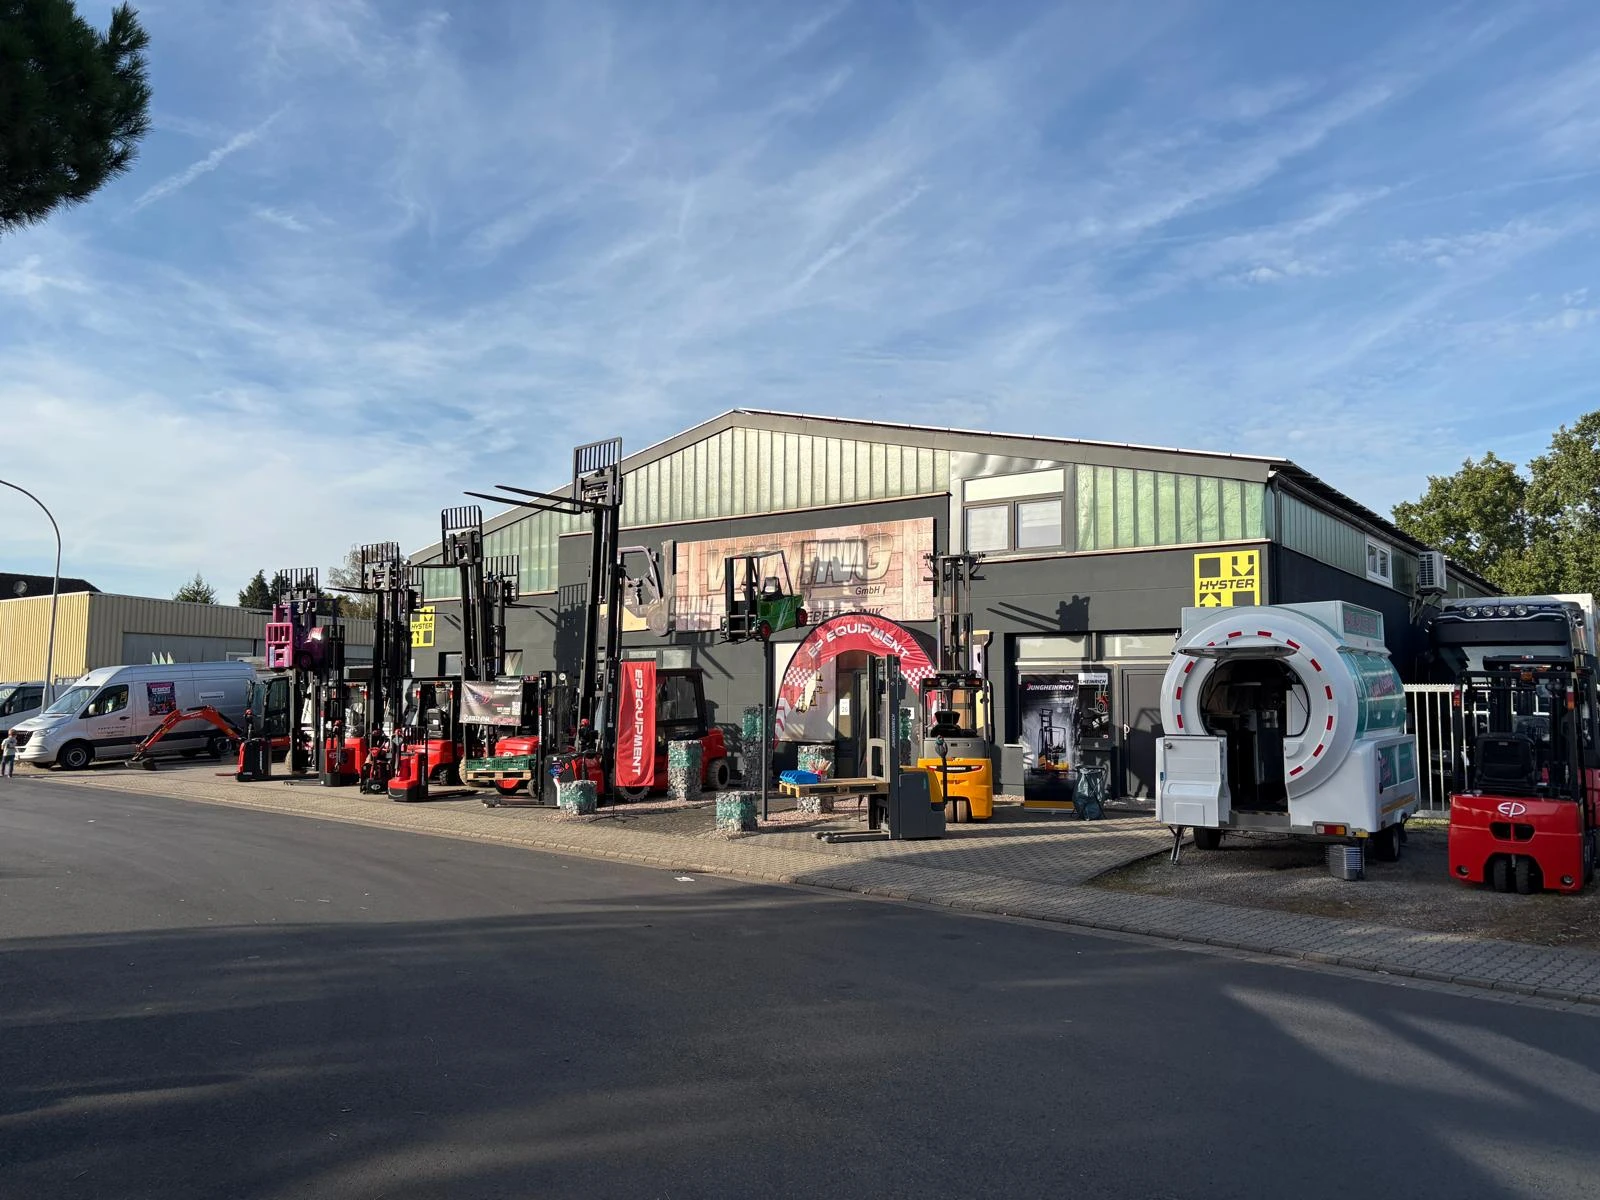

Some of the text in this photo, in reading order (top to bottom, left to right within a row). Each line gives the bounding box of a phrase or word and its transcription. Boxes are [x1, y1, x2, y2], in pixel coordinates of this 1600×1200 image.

[1199, 578, 1255, 590] HYSTER
[855, 586, 880, 596] GmbH
[411, 622, 433, 630] HYSTER
[808, 623, 909, 658] EP EQUIPMENT
[1498, 802, 1526, 817] EP
